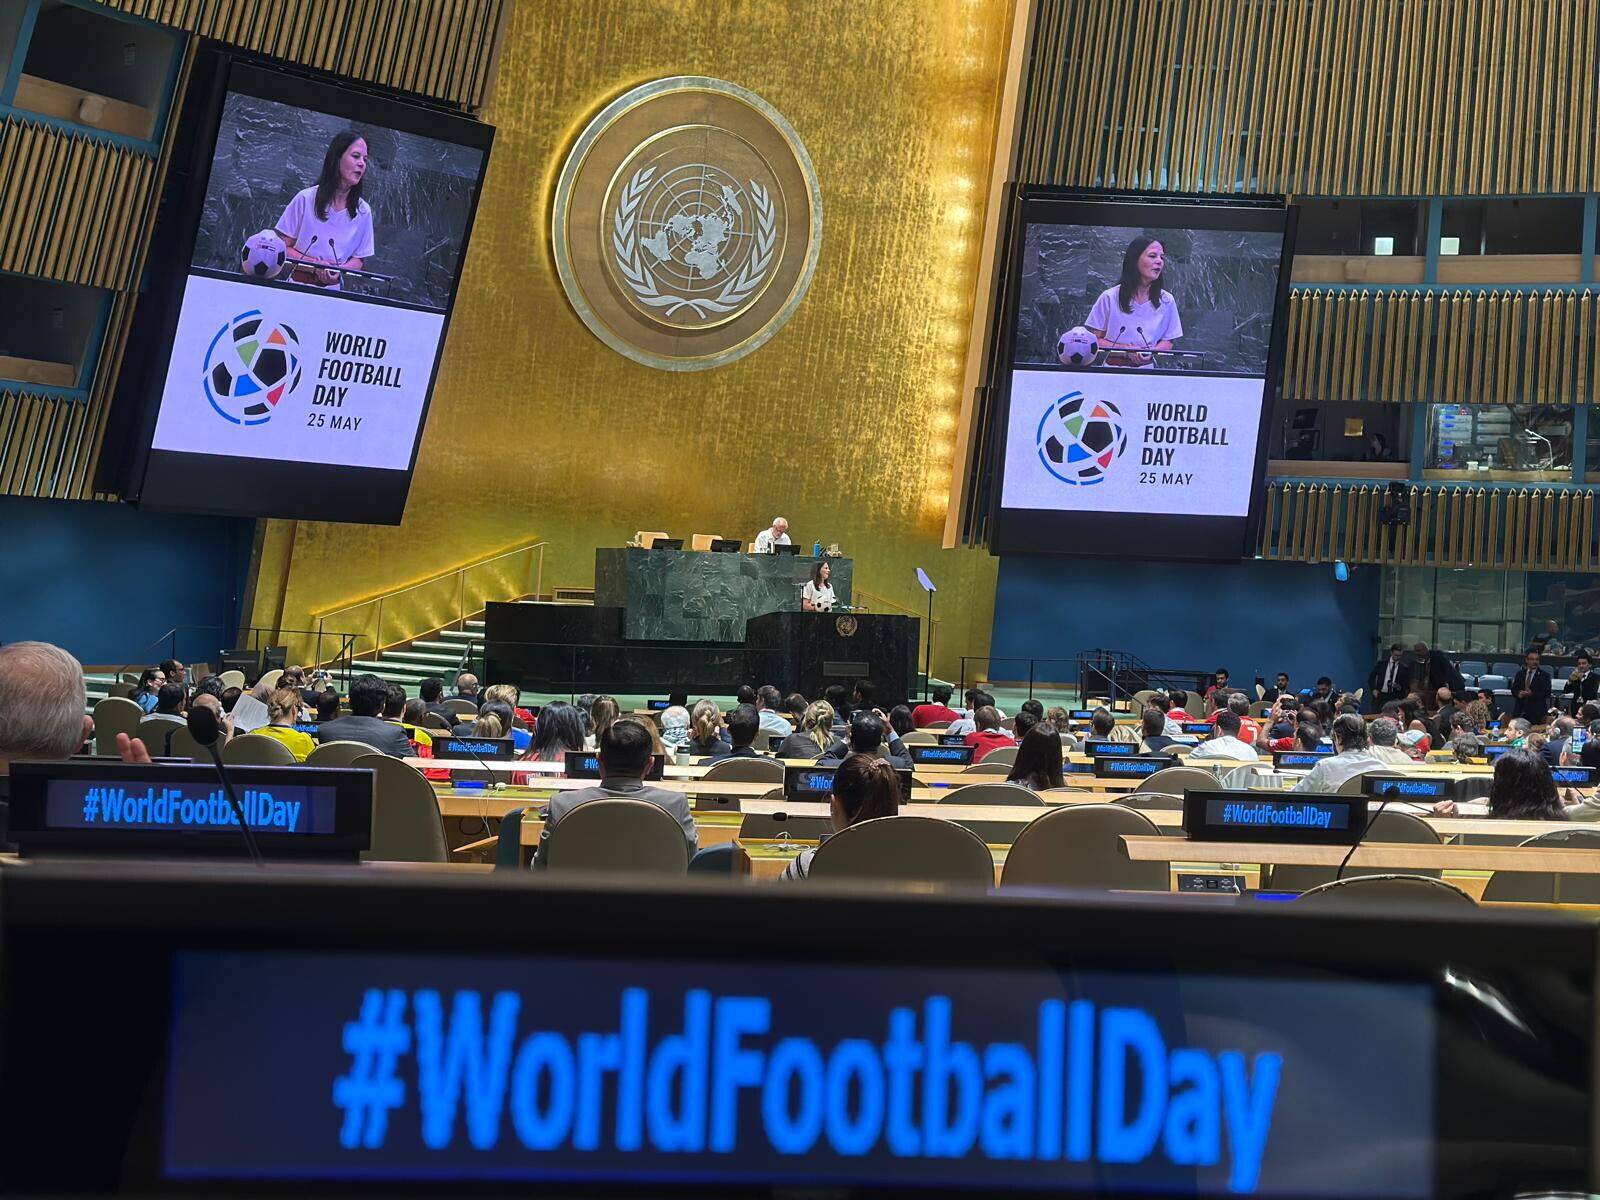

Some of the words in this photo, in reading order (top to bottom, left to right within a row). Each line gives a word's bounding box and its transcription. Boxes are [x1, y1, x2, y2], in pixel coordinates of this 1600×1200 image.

[324, 331, 387, 360] WORLD
[317, 358, 402, 389] FOOTBALL
[311, 384, 349, 408] DAY
[307, 413, 326, 428] 25
[330, 415, 362, 431] MAY
[1147, 403, 1208, 423] WORLD
[1143, 425, 1229, 446] FOOTBALL
[1141, 448, 1176, 466] DAY
[1139, 472, 1157, 484] 25
[1162, 473, 1193, 485] MAY
[83, 788, 300, 832] #WorldFootballDay
[1223, 804, 1332, 828] #WorldFootballDay
[334, 989, 1282, 1193] #WorldFootballDay
